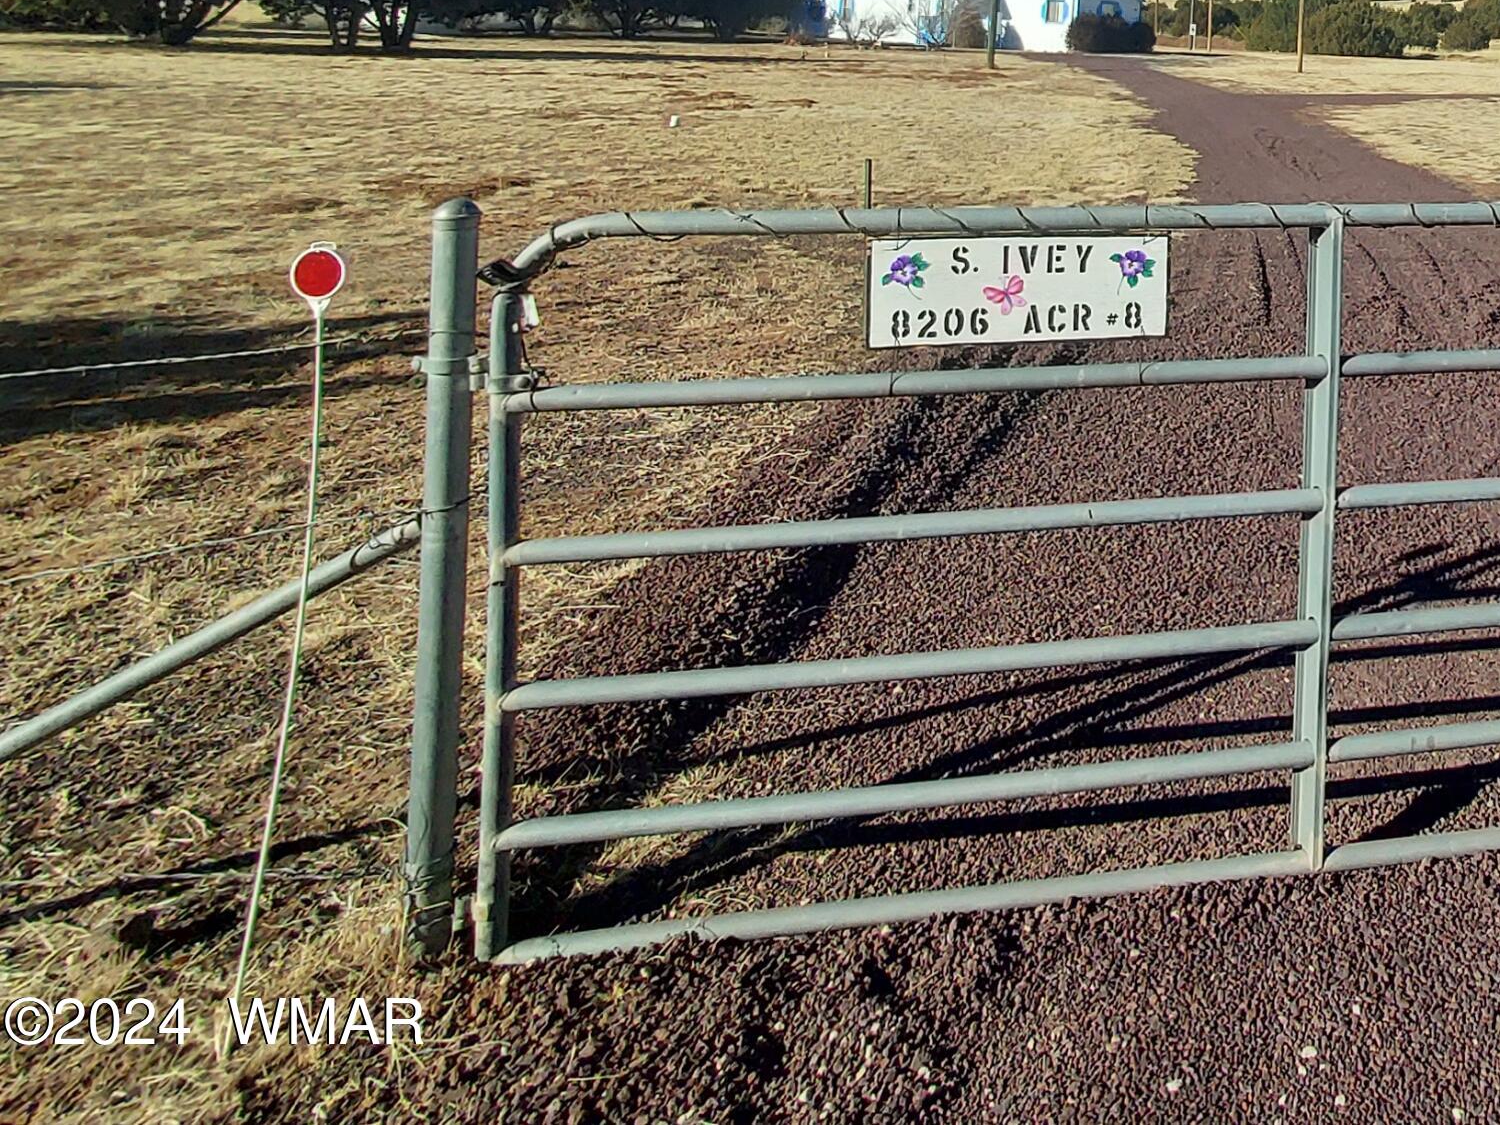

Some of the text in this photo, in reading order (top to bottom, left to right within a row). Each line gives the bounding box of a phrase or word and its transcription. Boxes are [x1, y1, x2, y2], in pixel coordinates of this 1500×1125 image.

[950, 244, 1094, 275] S. IVEY
[891, 301, 1142, 339] 8206 ACR #8
